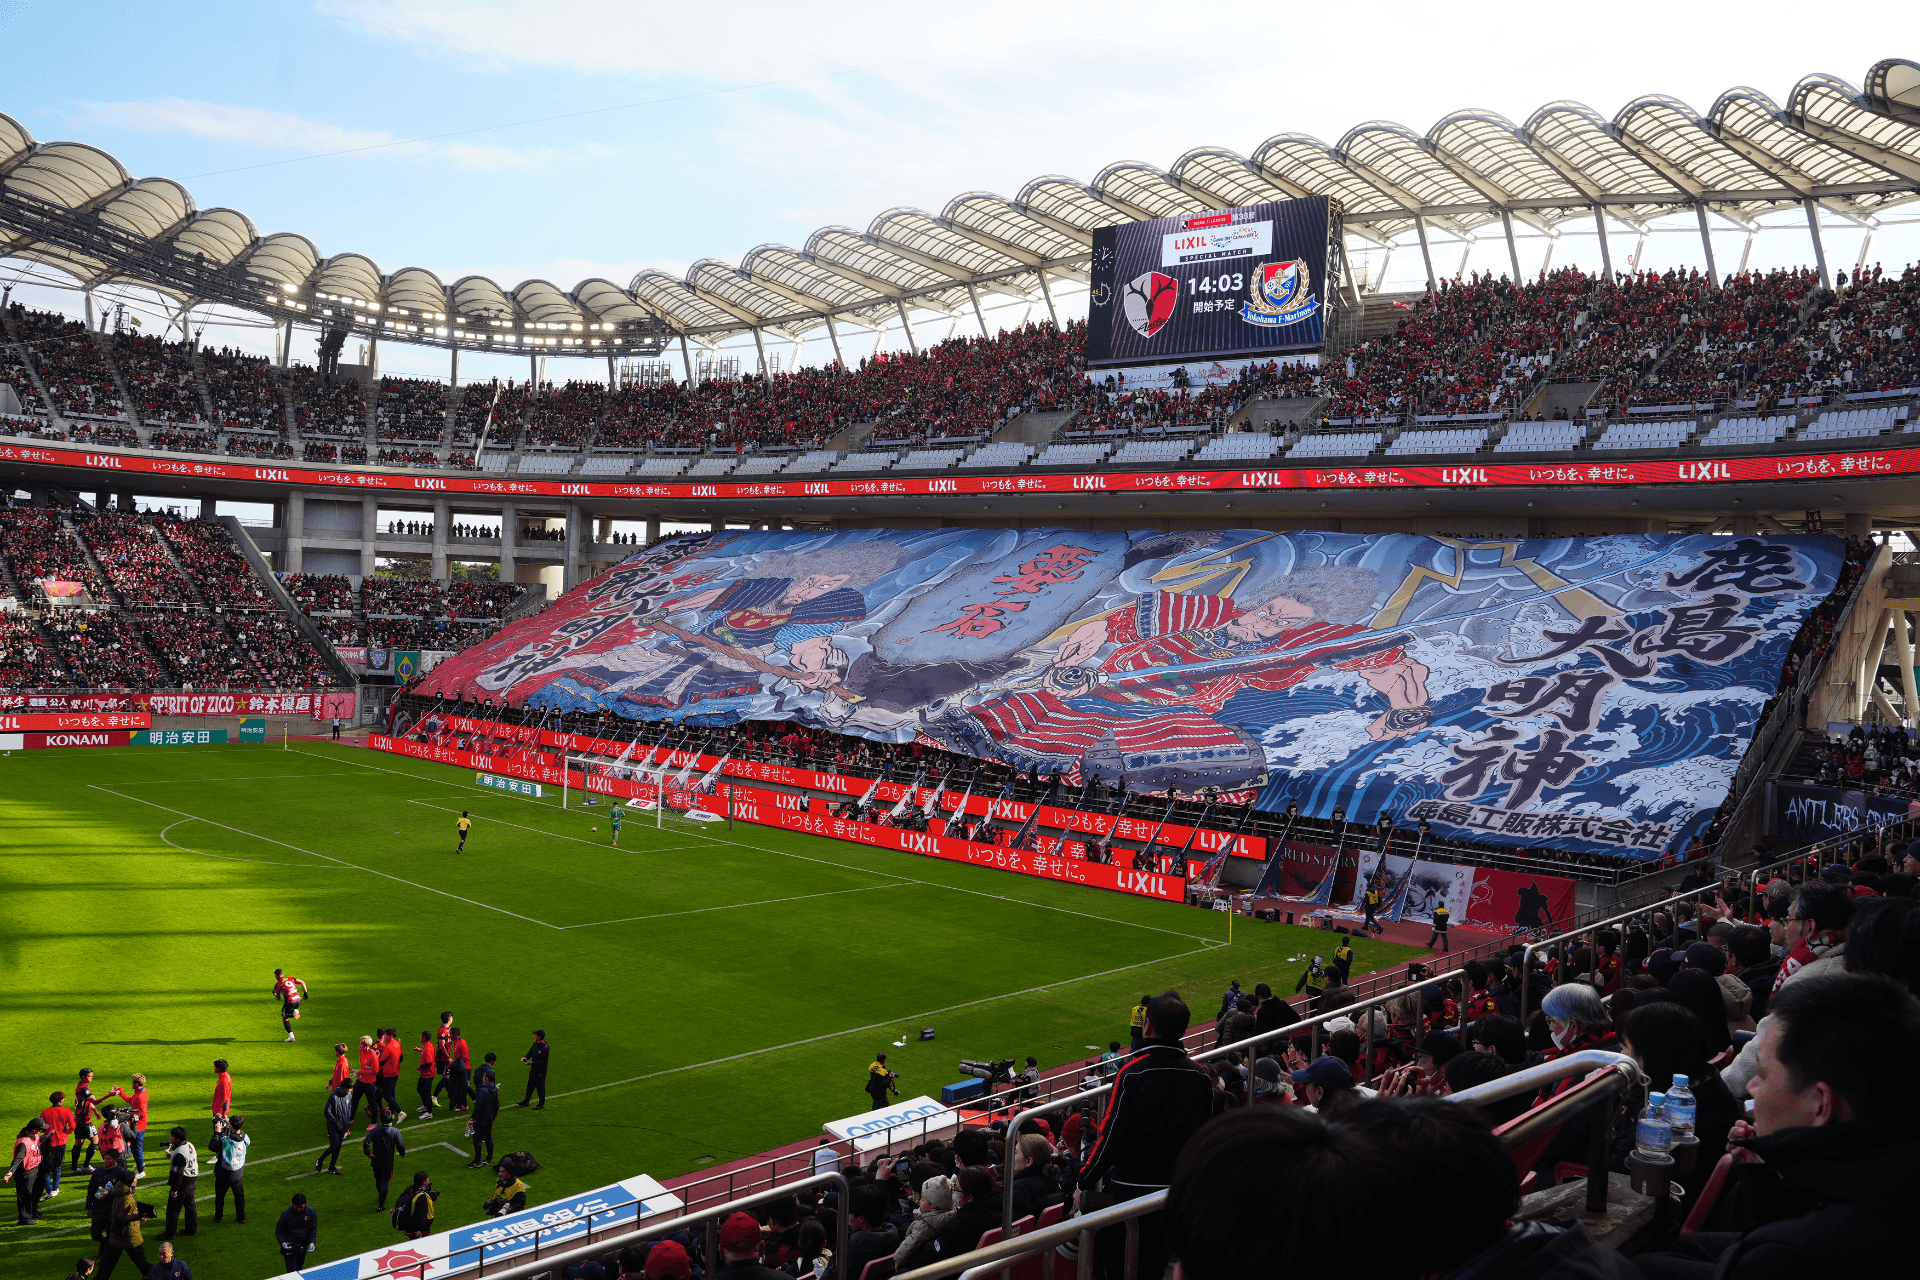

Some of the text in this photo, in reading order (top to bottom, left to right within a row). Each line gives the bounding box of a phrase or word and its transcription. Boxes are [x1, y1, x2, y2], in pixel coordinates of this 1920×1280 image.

[1175, 236, 1207, 250] LIXIL
[1185, 249, 1247, 261] SPECIAL MATCH
[1188, 273, 1243, 295] 14:03
[1193, 298, 1235, 314] 開始予定
[1247, 311, 1277, 324] Yokohama
[87, 456, 121, 467] LIXIL
[153, 460, 225, 475] いつもを、幸せに。
[1778, 457, 1890, 473] いつもを、幸せに。
[256, 469, 289, 480] LIXIL
[1317, 471, 1403, 484] いつもを、幸せに。
[1443, 468, 1488, 484] LIXIL
[1531, 467, 1634, 480] いつもを、幸せに。
[1679, 462, 1730, 480] LIXIL
[319, 475, 387, 485] いつもを、幸せに。
[415, 479, 446, 489] LIXIL
[929, 479, 957, 492] LIXIL
[983, 479, 1046, 489] いつもを、幸せに。
[1074, 476, 1106, 489] LIXIL
[1136, 475, 1210, 486] いつもを、幸せに。
[1243, 472, 1281, 486] LIXIL
[474, 483, 536, 492] いつもを、幸せに。
[562, 484, 590, 494] LIXIL
[615, 487, 670, 495] いつもを、幸せに。
[693, 486, 716, 496] LIXIL
[738, 486, 785, 494] いつもを、幸せに。
[805, 483, 829, 494] LIXIL
[851, 482, 905, 492] いつもを、幸せに。
[920, 545, 1106, 639] 要石
[1444, 540, 1806, 811] 鹿島大明神
[150, 696, 235, 713] SPIRIT OF ZICO
[59, 716, 144, 726] いつもを、幸せに。
[46, 734, 109, 747] KONAMI
[150, 731, 210, 745] 明治安田
[374, 736, 393, 750] LIXIL
[404, 743, 458, 763] いつもを、幸せに。
[471, 754, 493, 769] LIXIL
[507, 762, 571, 784] いつもを、幸せに。
[484, 775, 532, 794] 明治安田
[587, 776, 613, 793] LIXIL
[815, 774, 848, 792] LIXIL
[776, 794, 800, 811] LIXI
[1784, 796, 1860, 833] ANTLERS
[781, 812, 876, 842] いつもを、幸せに。
[1411, 801, 1672, 849] 鹿島工販株式会社
[901, 833, 940, 853] LIXIL
[1284, 847, 1310, 863] RED
[968, 845, 1086, 881] いつもを、幸せに。
[1117, 870, 1167, 895] LIXIL
[285, 980, 296, 993] 9
[846, 1105, 948, 1139] omron
[471, 1197, 617, 1252] 常陽銀行
